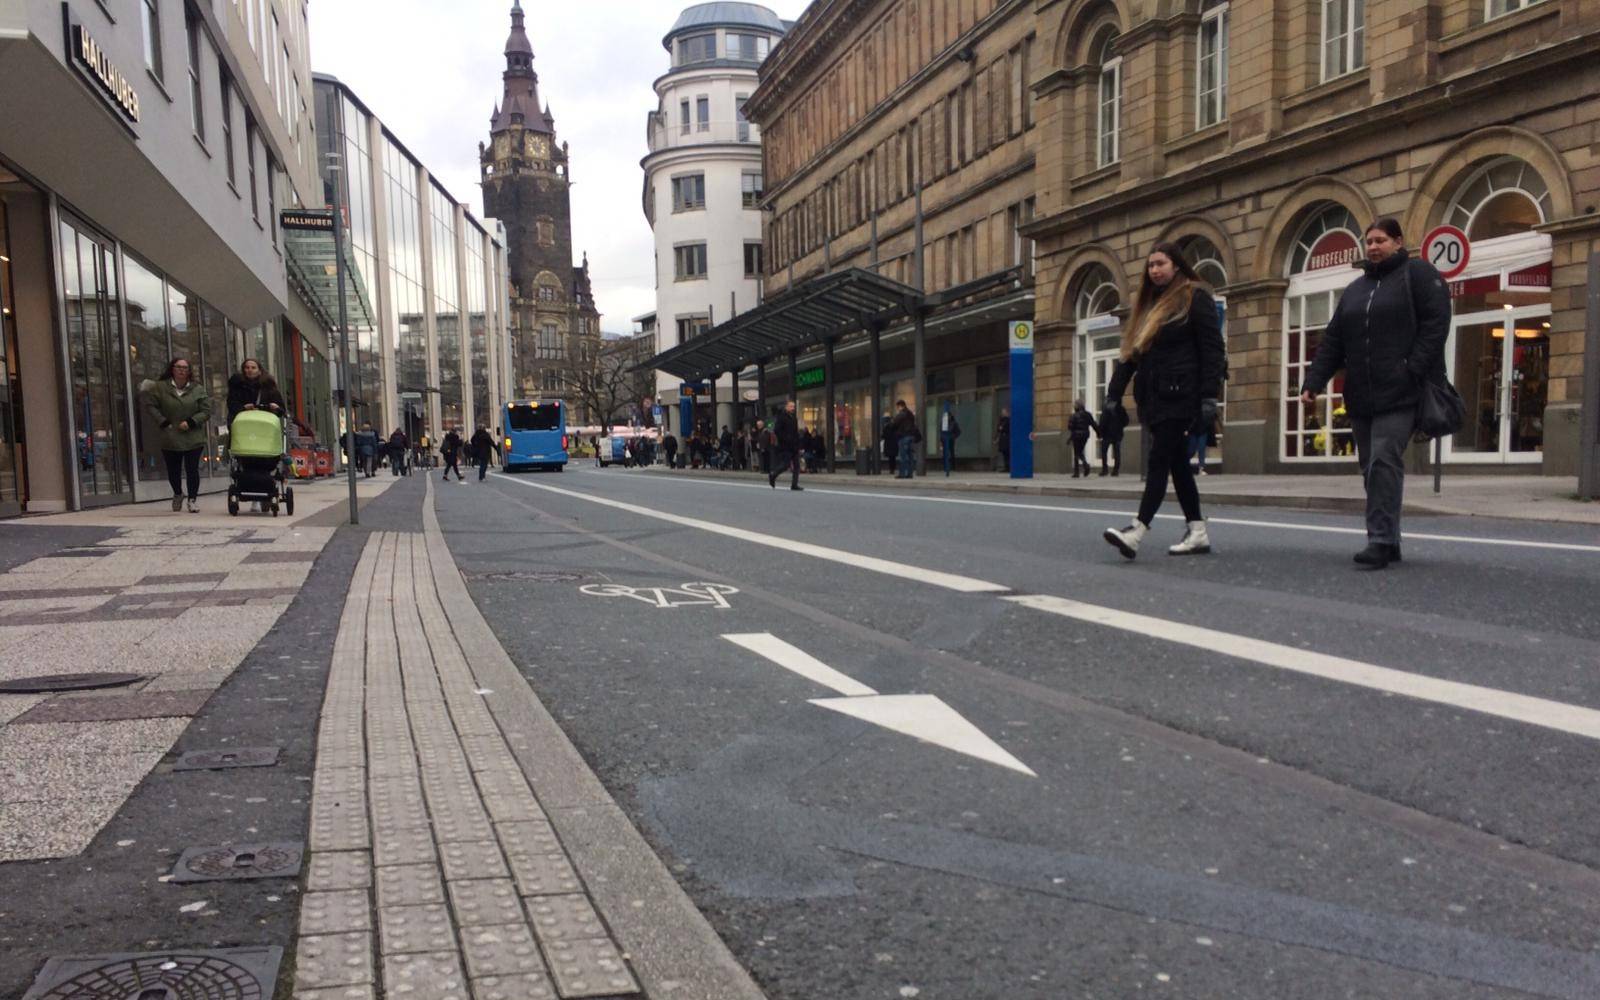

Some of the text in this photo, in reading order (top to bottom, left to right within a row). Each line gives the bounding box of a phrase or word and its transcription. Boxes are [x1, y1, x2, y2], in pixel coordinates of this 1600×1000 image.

[80, 25, 139, 122] HALLHUBER
[284, 216, 333, 226] HALLHUBER
[1433, 241, 1460, 265] 20
